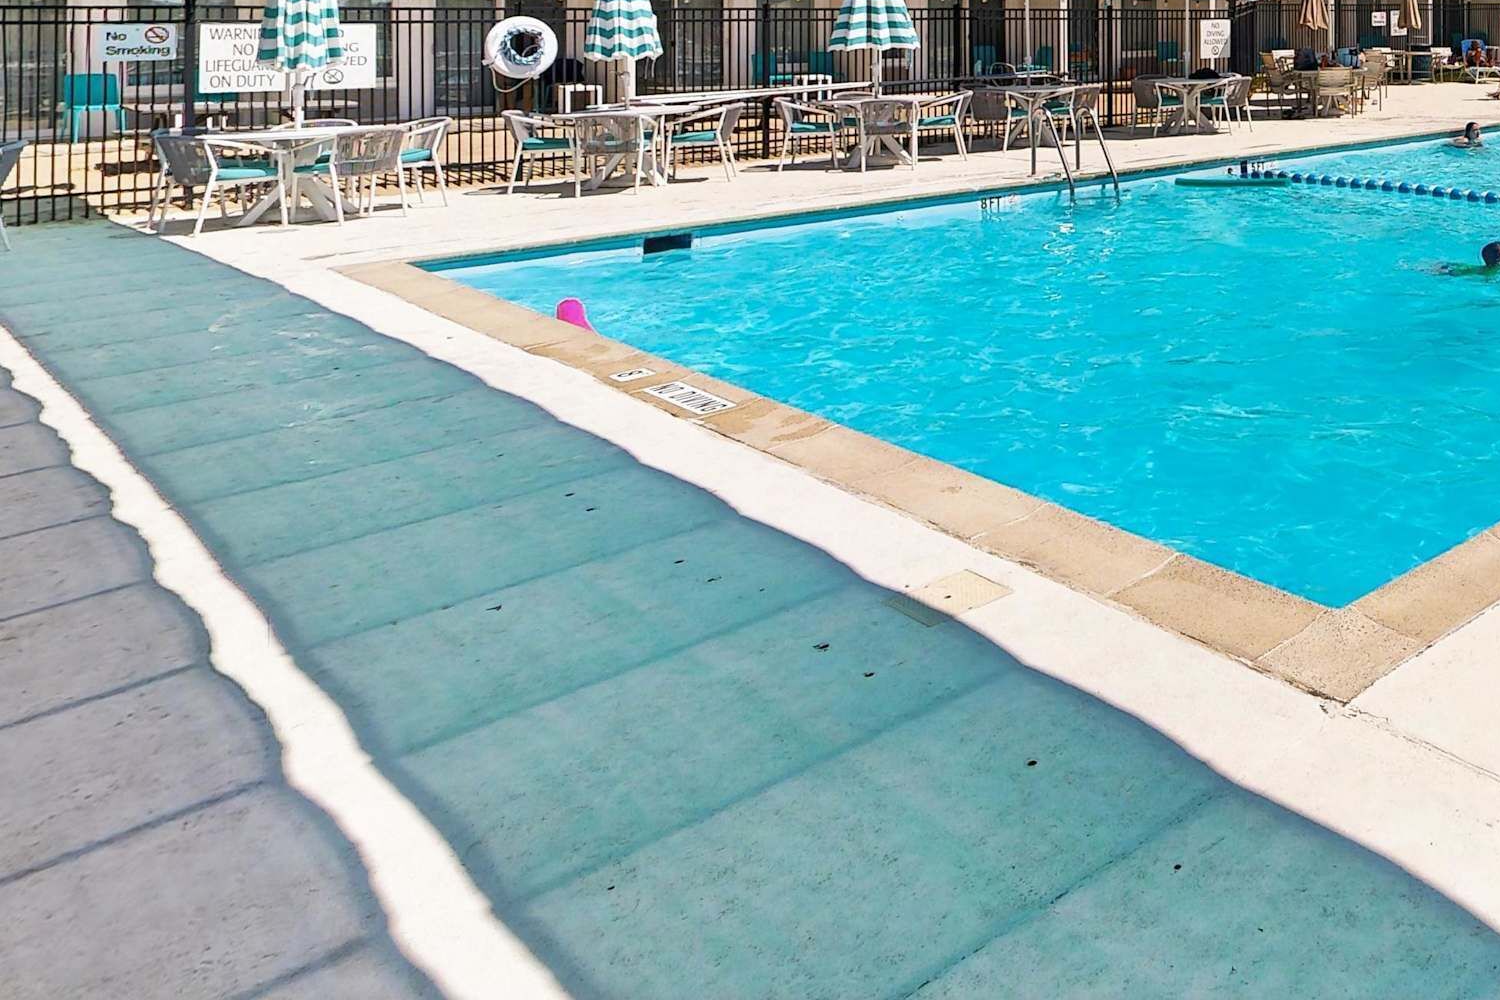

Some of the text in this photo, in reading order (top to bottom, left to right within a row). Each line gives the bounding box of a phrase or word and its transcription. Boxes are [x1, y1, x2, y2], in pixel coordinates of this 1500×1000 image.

[105, 32, 127, 41] No
[209, 27, 261, 40] WARNI
[1206, 30, 1225, 38] DIVING
[105, 45, 170, 56] Smoking
[232, 43, 255, 56] NO
[209, 74, 276, 88] ON DUTY
[649, 383, 728, 412] NO DIVING
